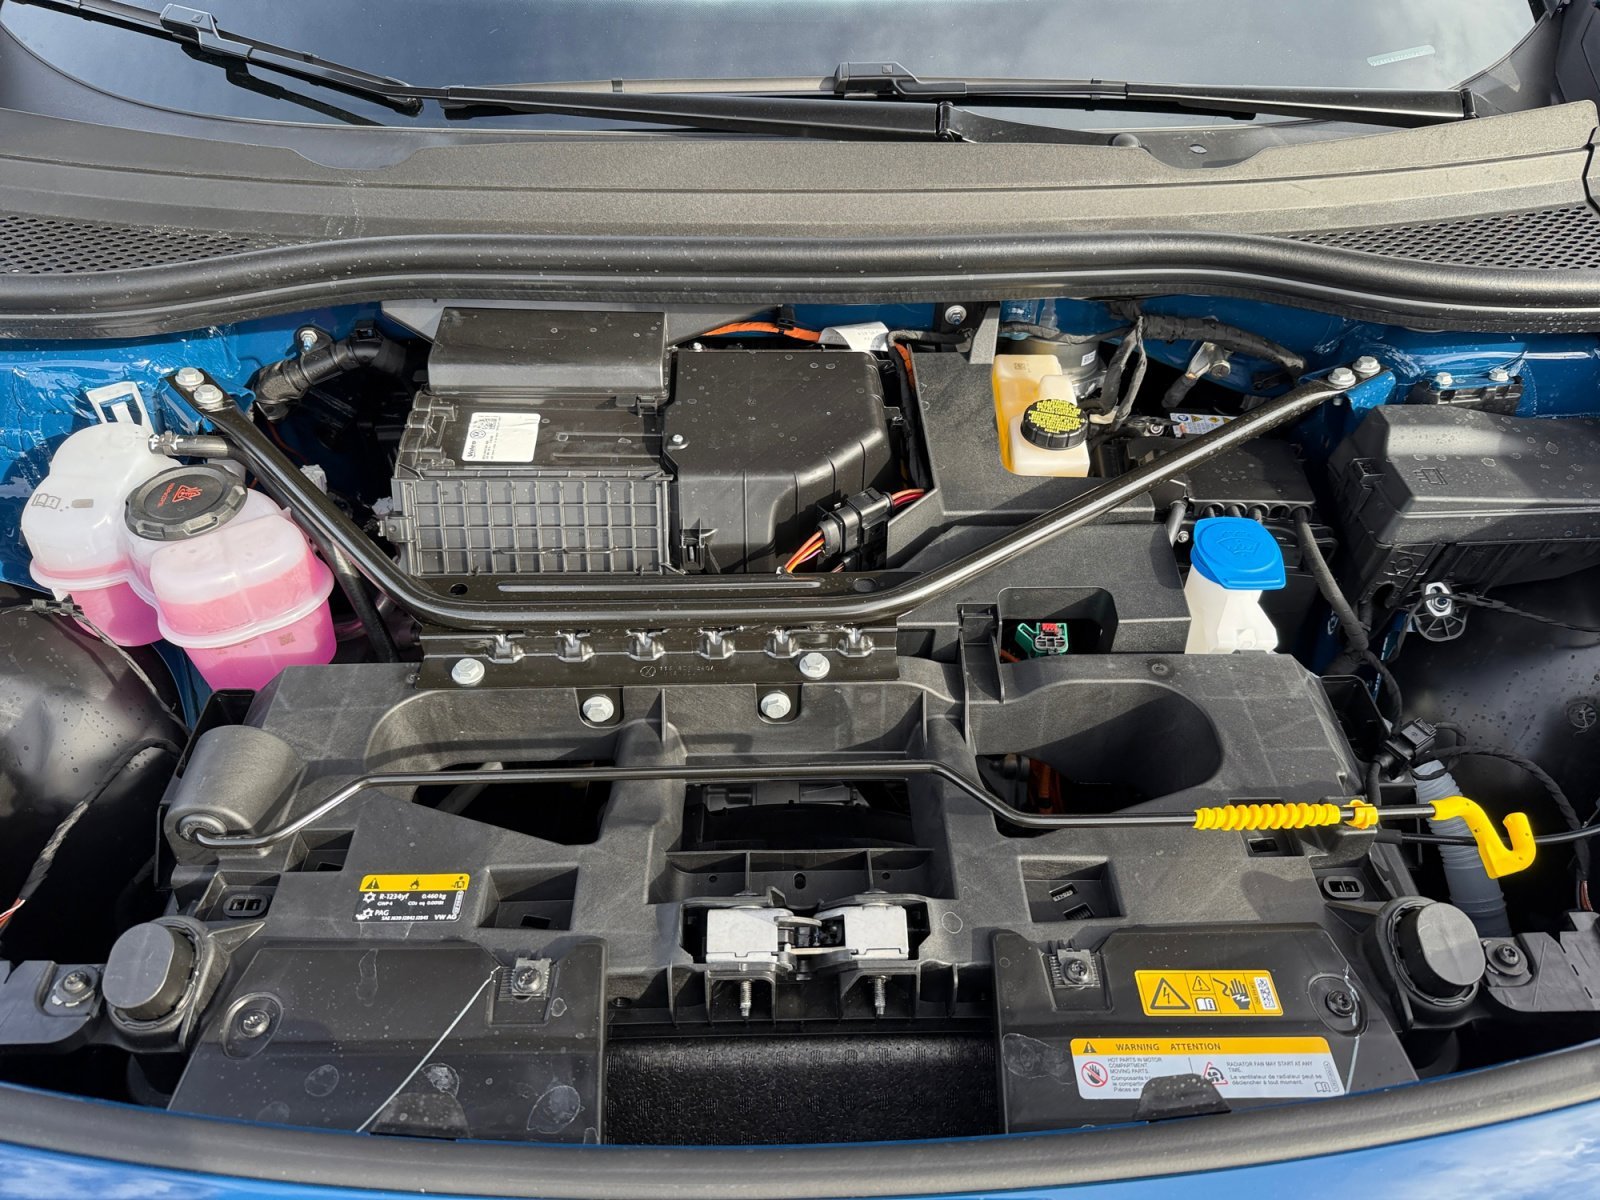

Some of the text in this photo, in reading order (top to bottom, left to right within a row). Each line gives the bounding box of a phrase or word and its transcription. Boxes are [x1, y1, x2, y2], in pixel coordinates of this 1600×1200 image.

[379, 893, 410, 901] R-1234yf
[1115, 1043, 1160, 1051] WARNING
[1170, 1043, 1221, 1051] ATTENTION
